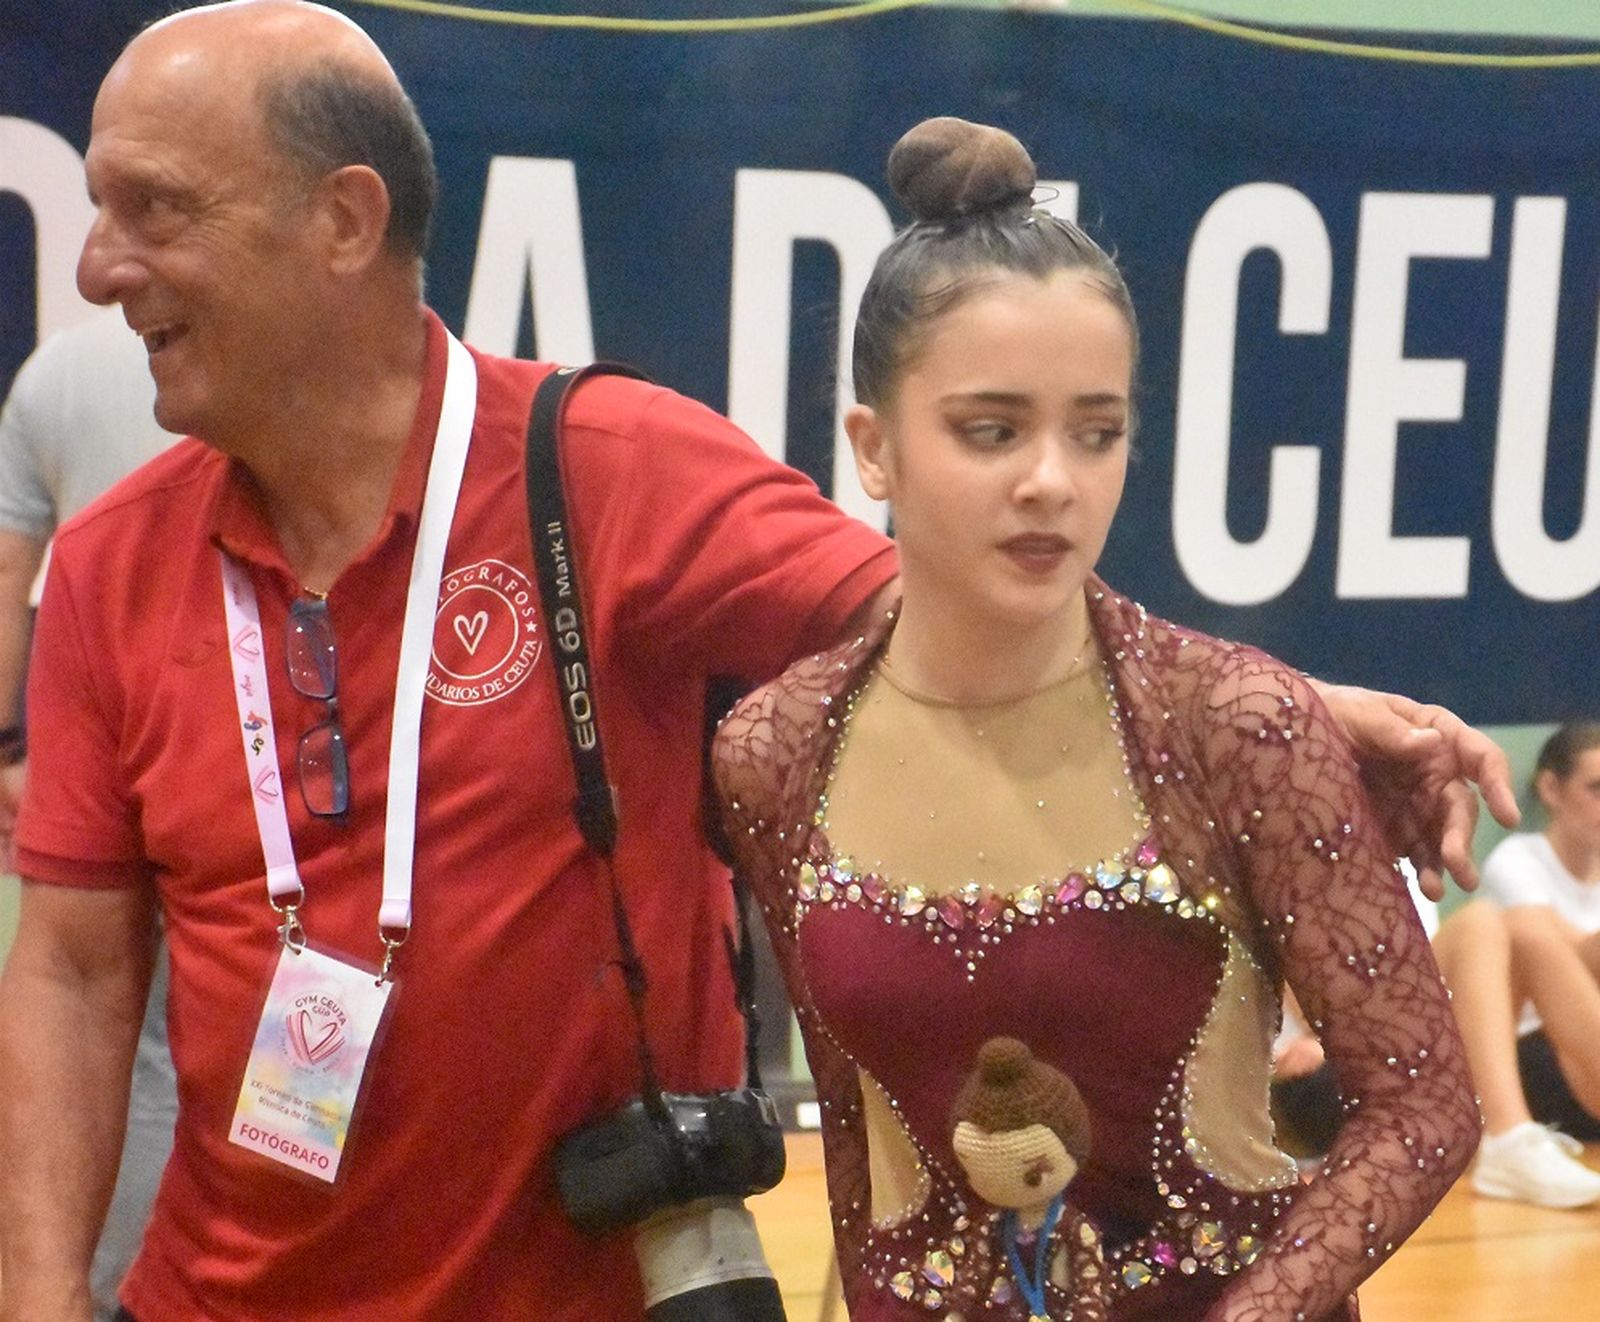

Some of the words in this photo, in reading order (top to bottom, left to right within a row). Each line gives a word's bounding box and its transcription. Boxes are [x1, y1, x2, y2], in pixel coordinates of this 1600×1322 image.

[440, 565, 536, 618] OGRAFOS
[550, 538, 571, 597] Mark
[555, 607, 580, 652] 6D
[425, 671, 480, 700] IDARIOS
[482, 678, 506, 697] DE
[503, 640, 538, 684] CEUTA
[564, 662, 596, 751] EOS
[295, 994, 318, 1008] GYM
[320, 996, 347, 1026] CEUTA
[311, 1005, 331, 1017] CUP
[239, 1122, 329, 1170] FOTÓGRAFO
